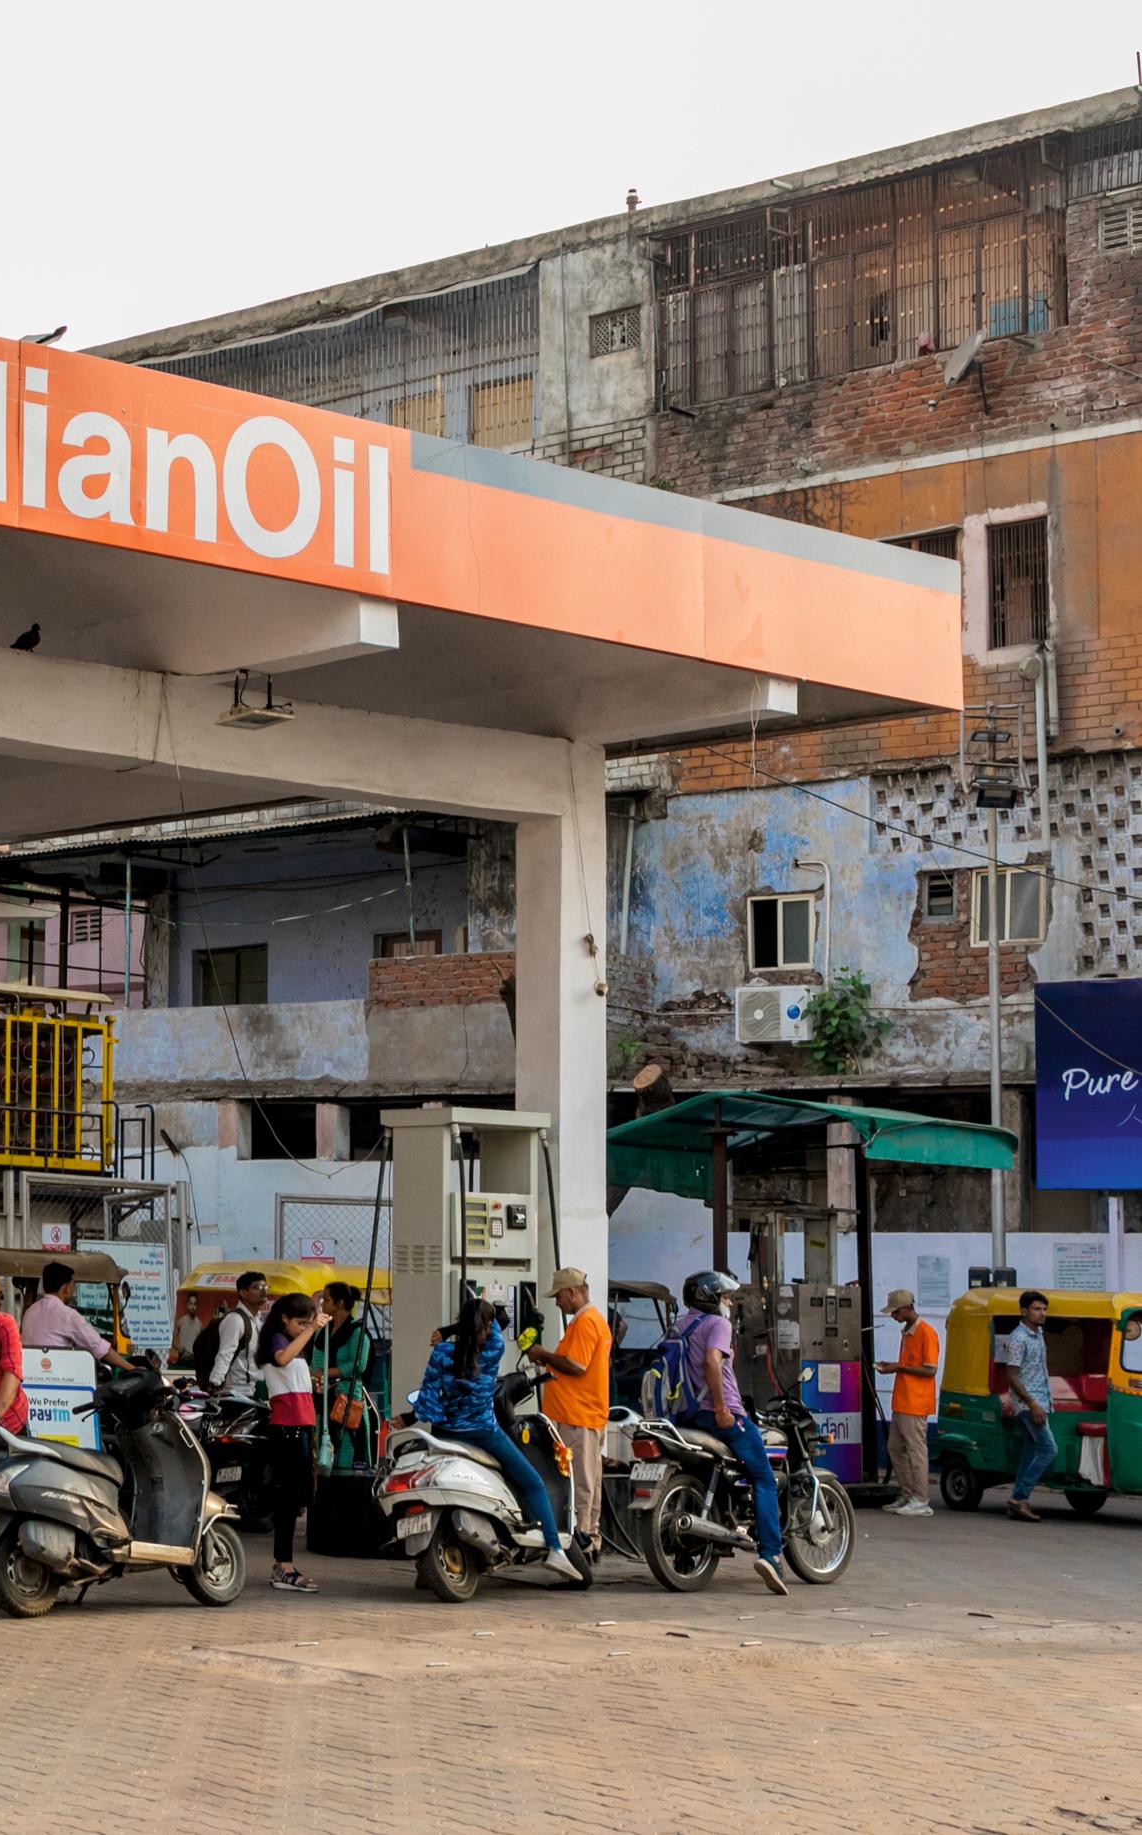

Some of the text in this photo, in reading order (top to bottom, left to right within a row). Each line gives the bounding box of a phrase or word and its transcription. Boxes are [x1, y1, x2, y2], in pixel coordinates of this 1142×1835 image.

[1061, 1067, 1139, 1101] Pure
[29, 1397, 69, 1407] We Prefer
[29, 1407, 71, 1422] paytm
